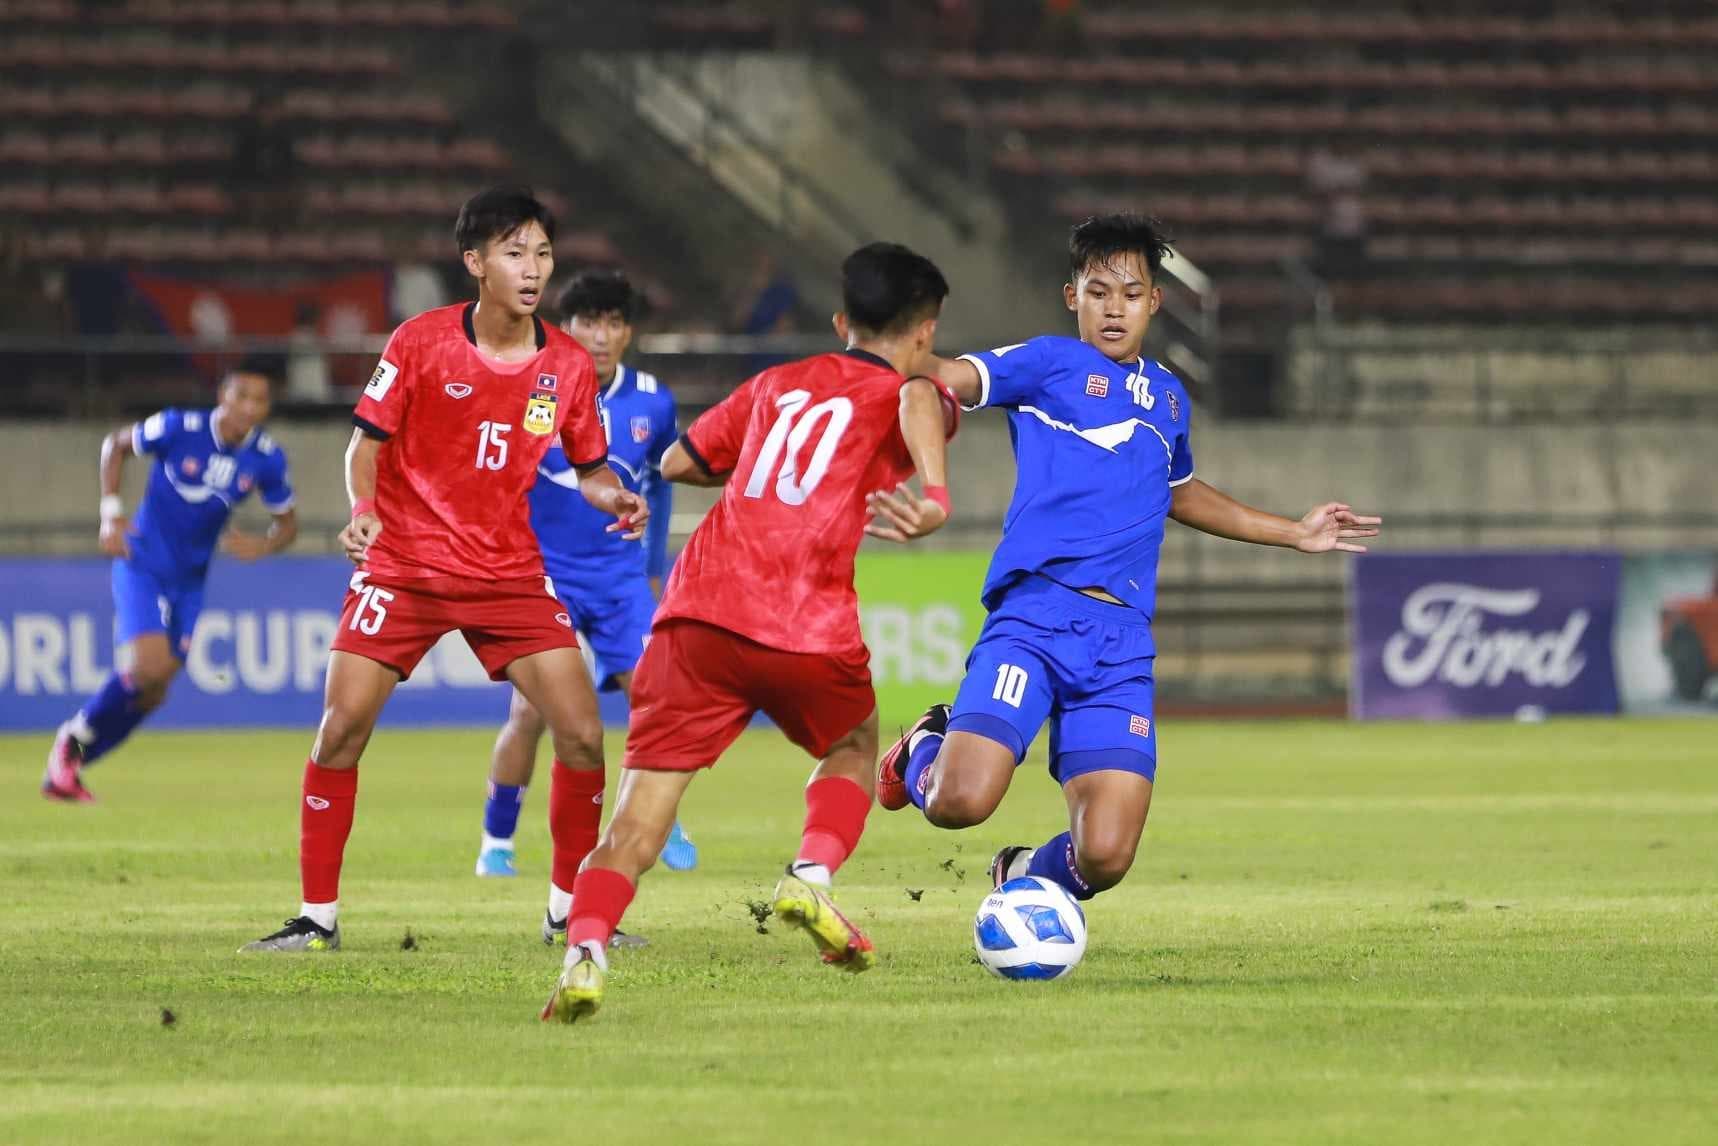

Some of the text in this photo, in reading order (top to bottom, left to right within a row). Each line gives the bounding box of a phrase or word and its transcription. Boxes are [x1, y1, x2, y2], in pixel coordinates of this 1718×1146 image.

[1125, 372, 1155, 410] 10
[475, 420, 512, 470] 15
[743, 388, 853, 506] 10
[349, 586, 395, 636] 15
[1382, 582, 1591, 688] Ford
[992, 663, 1029, 709] 10
